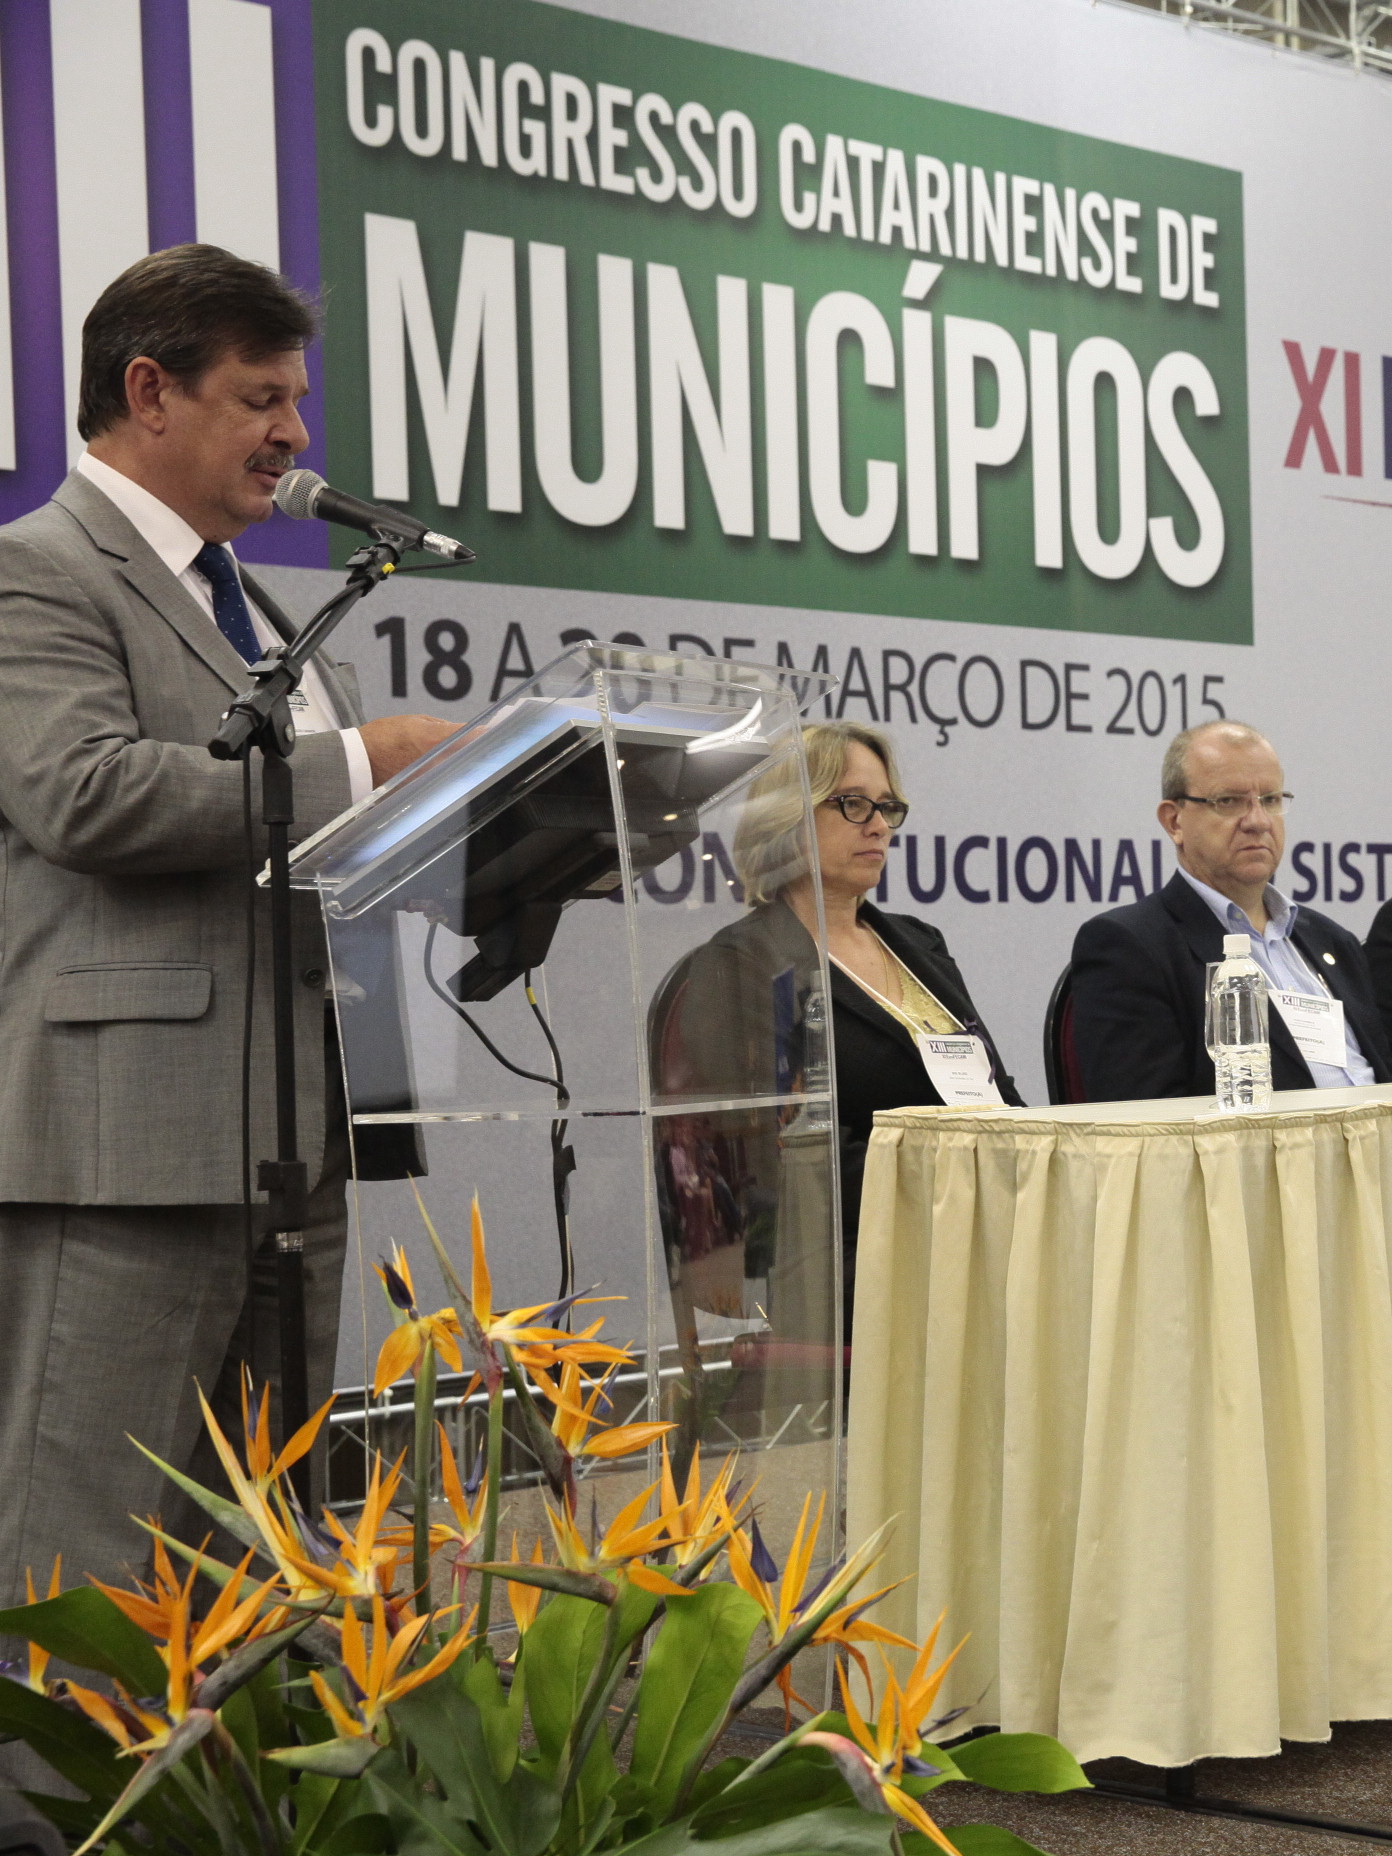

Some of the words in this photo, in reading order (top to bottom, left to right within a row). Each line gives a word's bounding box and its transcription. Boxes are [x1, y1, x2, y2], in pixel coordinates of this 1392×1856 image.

[345, 27, 757, 219] CONGRESSO
[778, 123, 1143, 294] CATARINENSE
[1157, 207, 1219, 308] DE
[364, 212, 1226, 588] MUNICÍPIOS
[1282, 339, 1364, 477] XI
[374, 616, 473, 701] 18
[489, 622, 543, 702] A
[669, 634, 756, 708] DE
[777, 641, 1004, 746] MARÇO
[1019, 659, 1093, 733] DE
[1106, 668, 1227, 738] 2015
